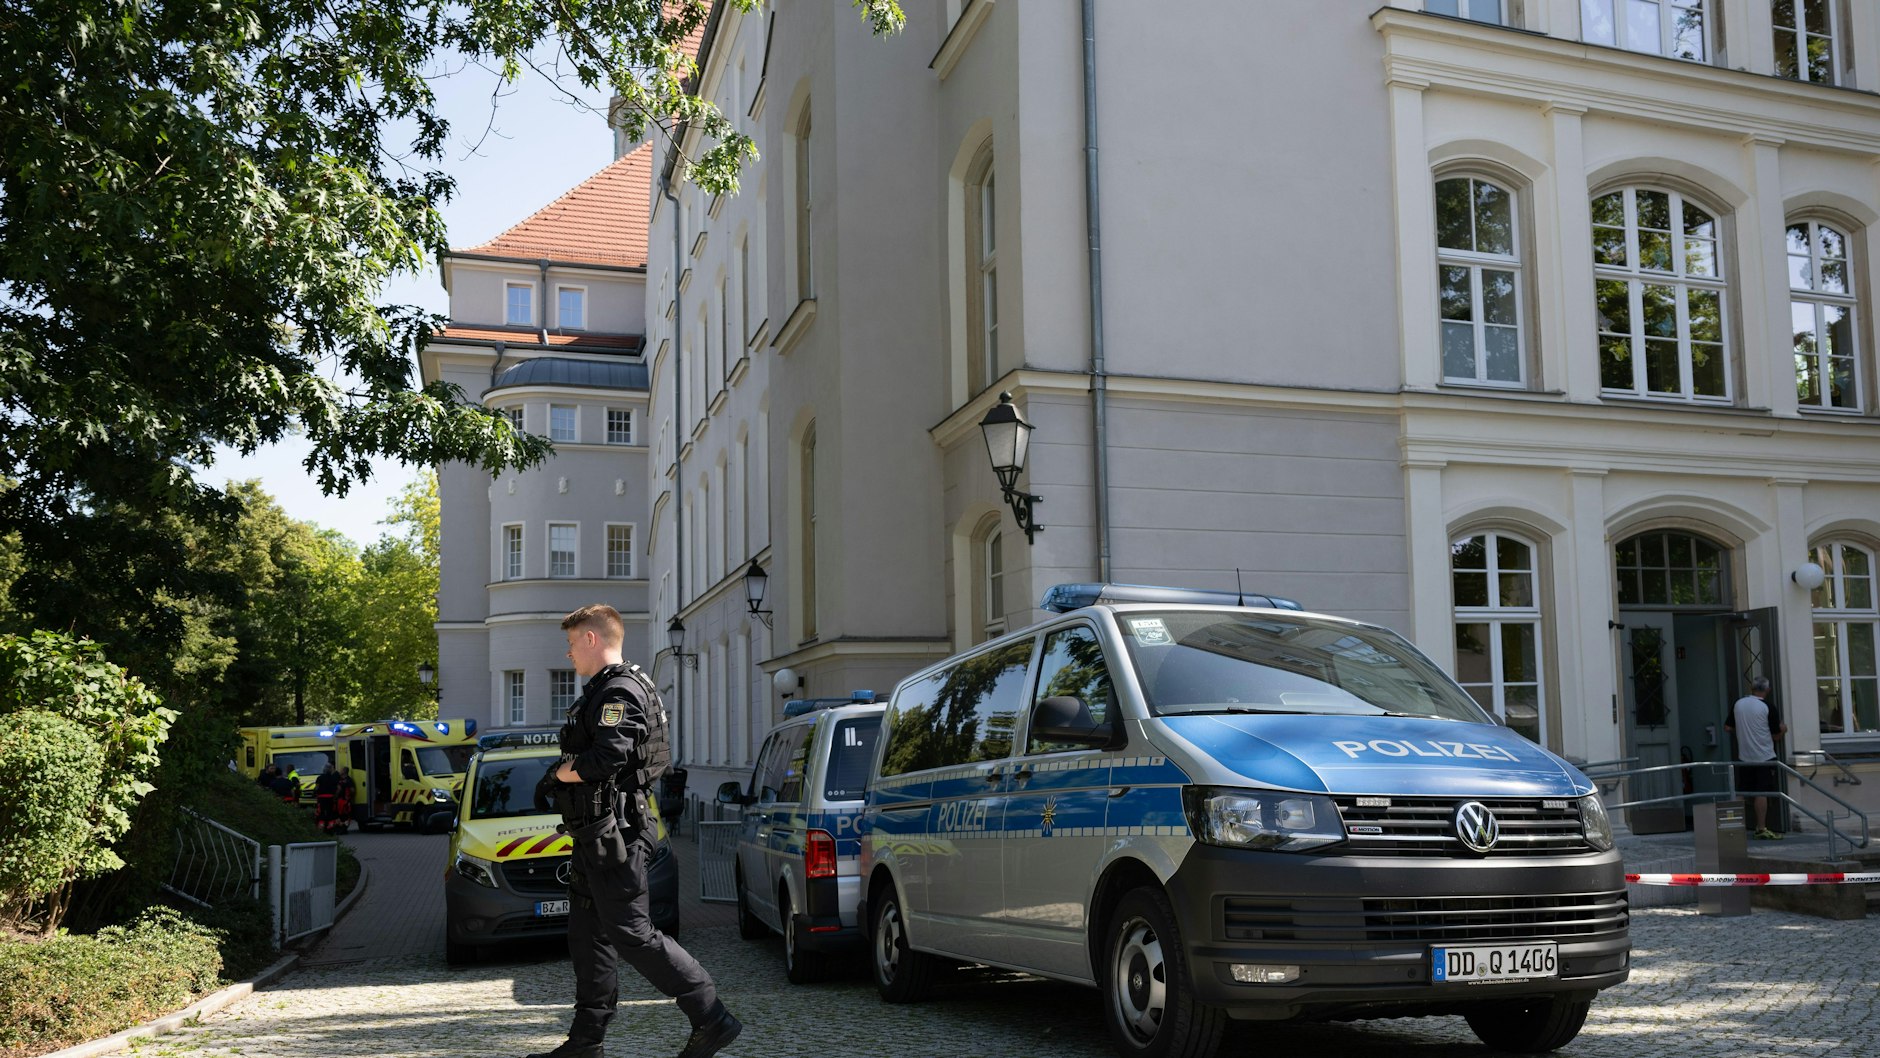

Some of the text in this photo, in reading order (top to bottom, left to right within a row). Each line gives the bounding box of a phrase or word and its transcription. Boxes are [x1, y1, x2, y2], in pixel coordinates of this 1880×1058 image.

[1332, 739, 1521, 763] POLIZEI
[937, 800, 989, 832] POLIZEI
[542, 902, 555, 913] BZ
[1447, 951, 1475, 976] DD
[1489, 950, 1503, 974] Q
[1508, 948, 1556, 974] 1406
